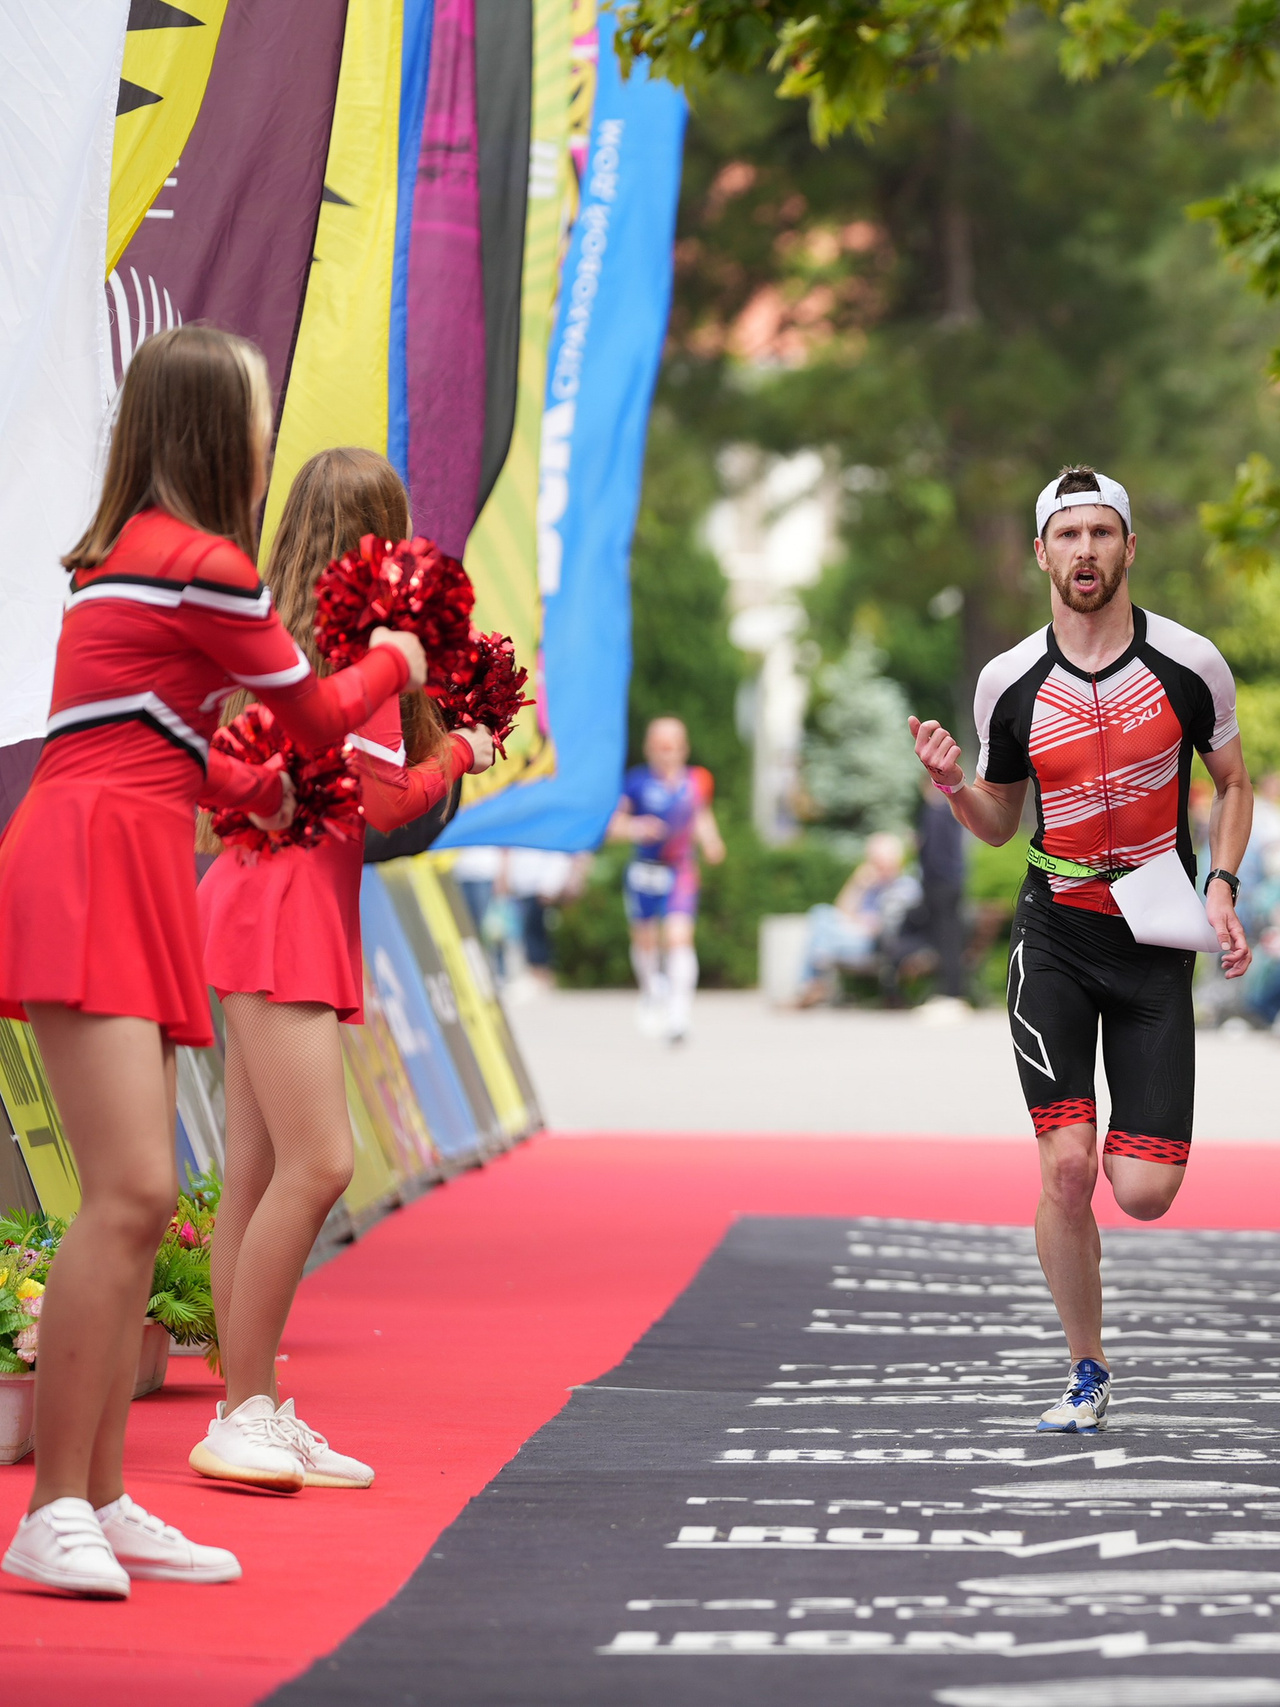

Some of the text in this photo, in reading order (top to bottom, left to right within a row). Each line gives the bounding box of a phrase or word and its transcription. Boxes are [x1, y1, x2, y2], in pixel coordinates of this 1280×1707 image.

[1121, 702, 1163, 734] 2XU
[718, 1447, 1027, 1461] IRON
[675, 1525, 1026, 1546] IRON
[610, 1630, 1017, 1651] IRON
